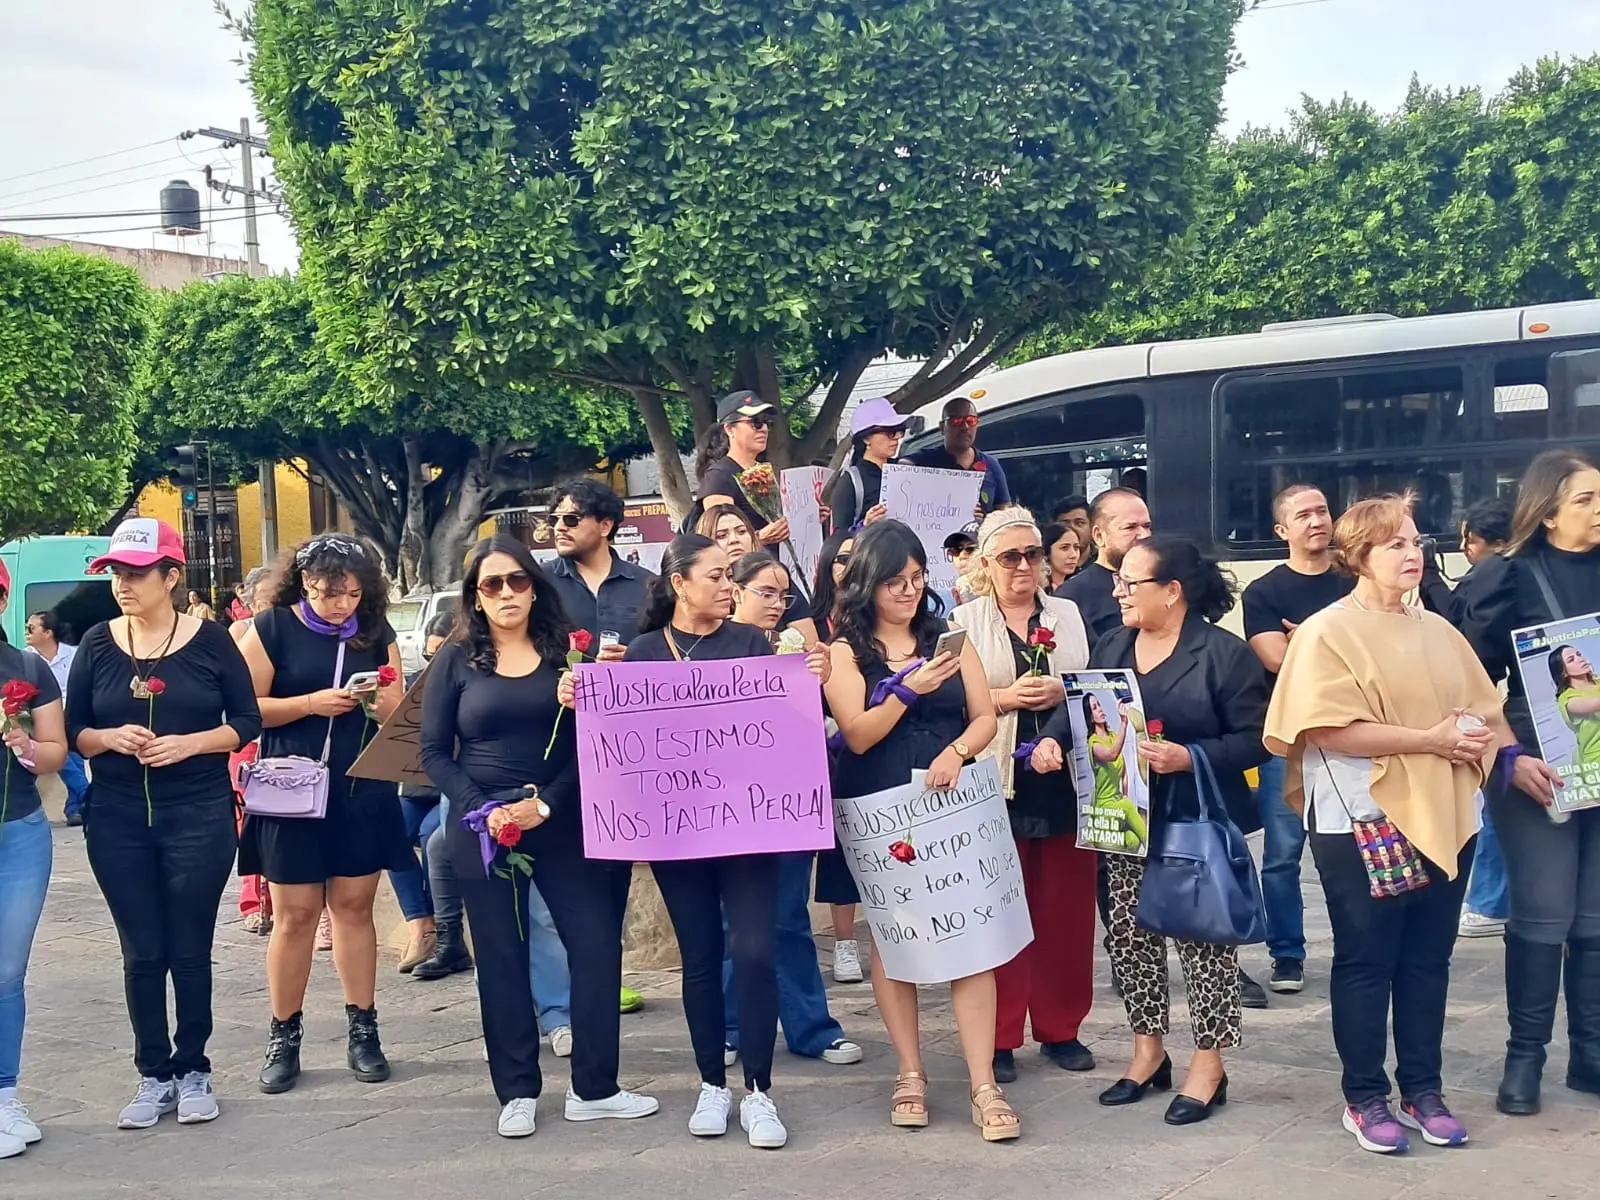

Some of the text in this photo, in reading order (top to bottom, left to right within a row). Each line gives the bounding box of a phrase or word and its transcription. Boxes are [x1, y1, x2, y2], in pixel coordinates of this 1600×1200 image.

[642, 503, 669, 516] PREPA
[916, 502, 934, 518] nos
[587, 719, 775, 773] ¡NO ESTAMOS
[1556, 764, 1582, 776] Ella
[661, 800, 740, 835] FALTA
[748, 782, 825, 830] PERLA!
[1087, 816, 1120, 831] a ella la
[1081, 828, 1125, 846] MATARON
[903, 830, 972, 867] uerpo
[860, 879, 886, 906] NO
[925, 871, 970, 895] toca,
[978, 855, 1000, 881] NO
[931, 911, 966, 937] NO
